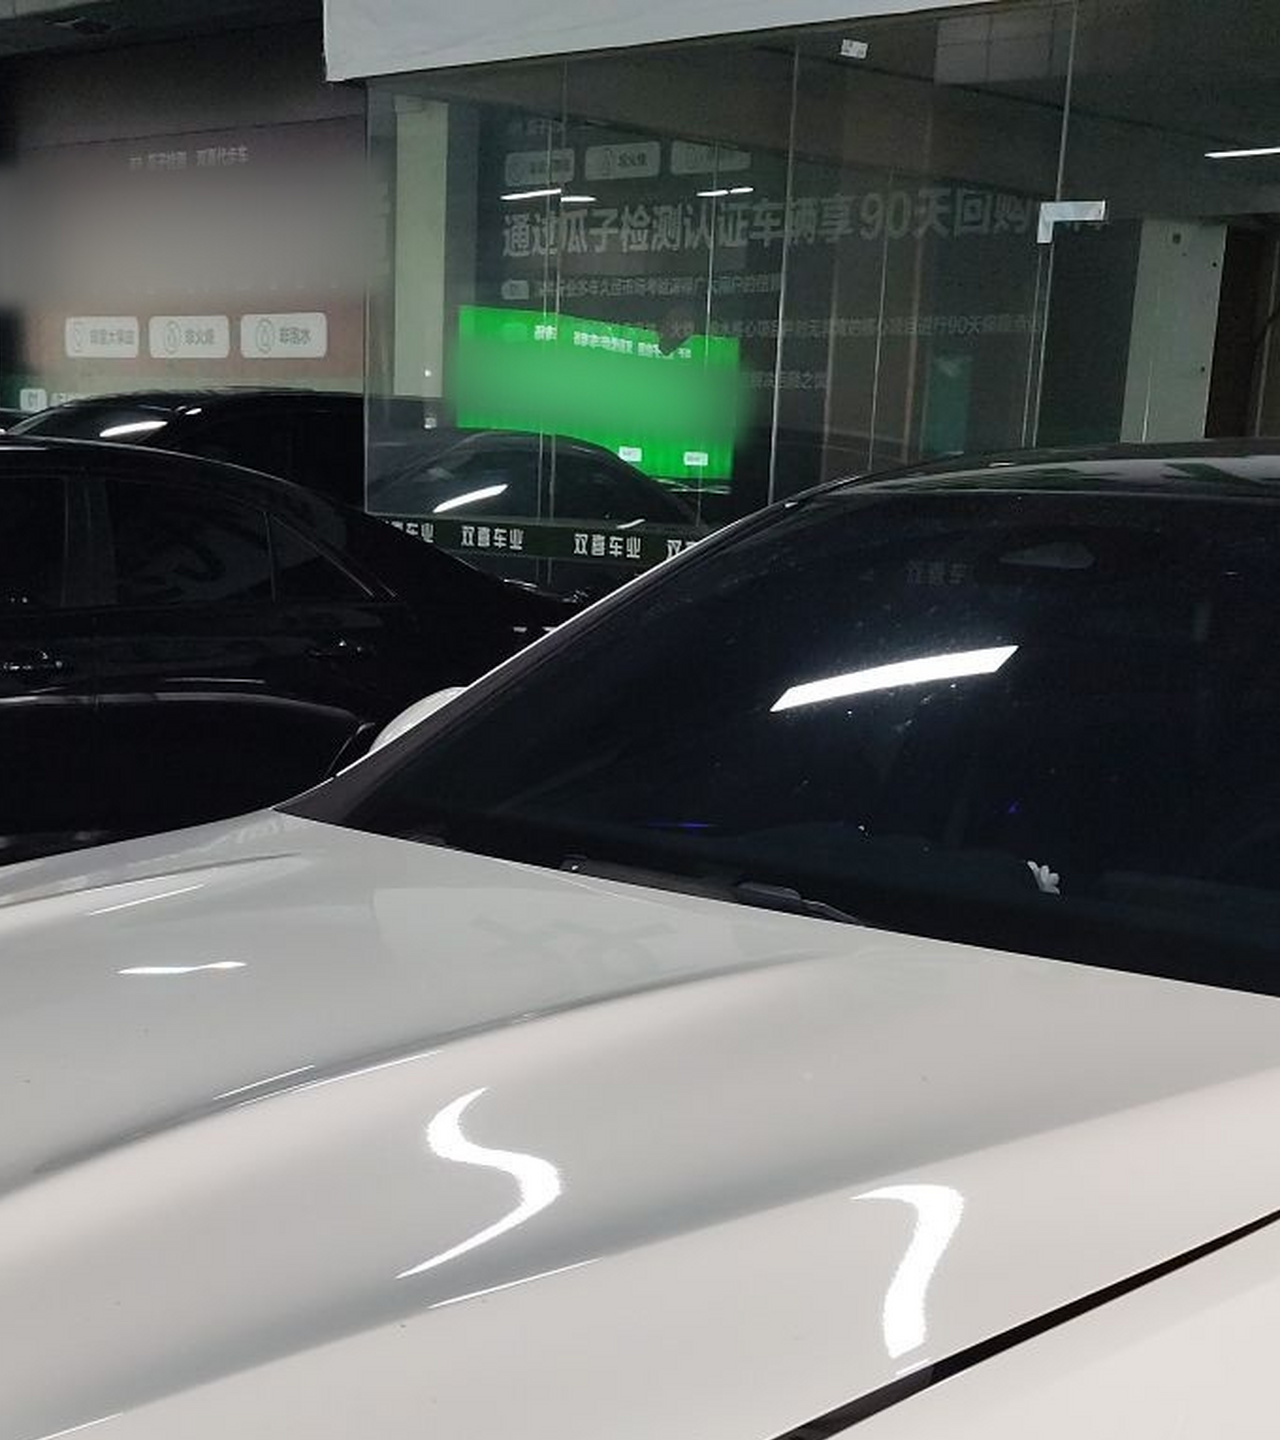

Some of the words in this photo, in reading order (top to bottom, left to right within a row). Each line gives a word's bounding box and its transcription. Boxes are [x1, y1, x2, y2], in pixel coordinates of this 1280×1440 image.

[460, 525, 524, 551] 双喜车业
[573, 532, 642, 559] 双喜车业
